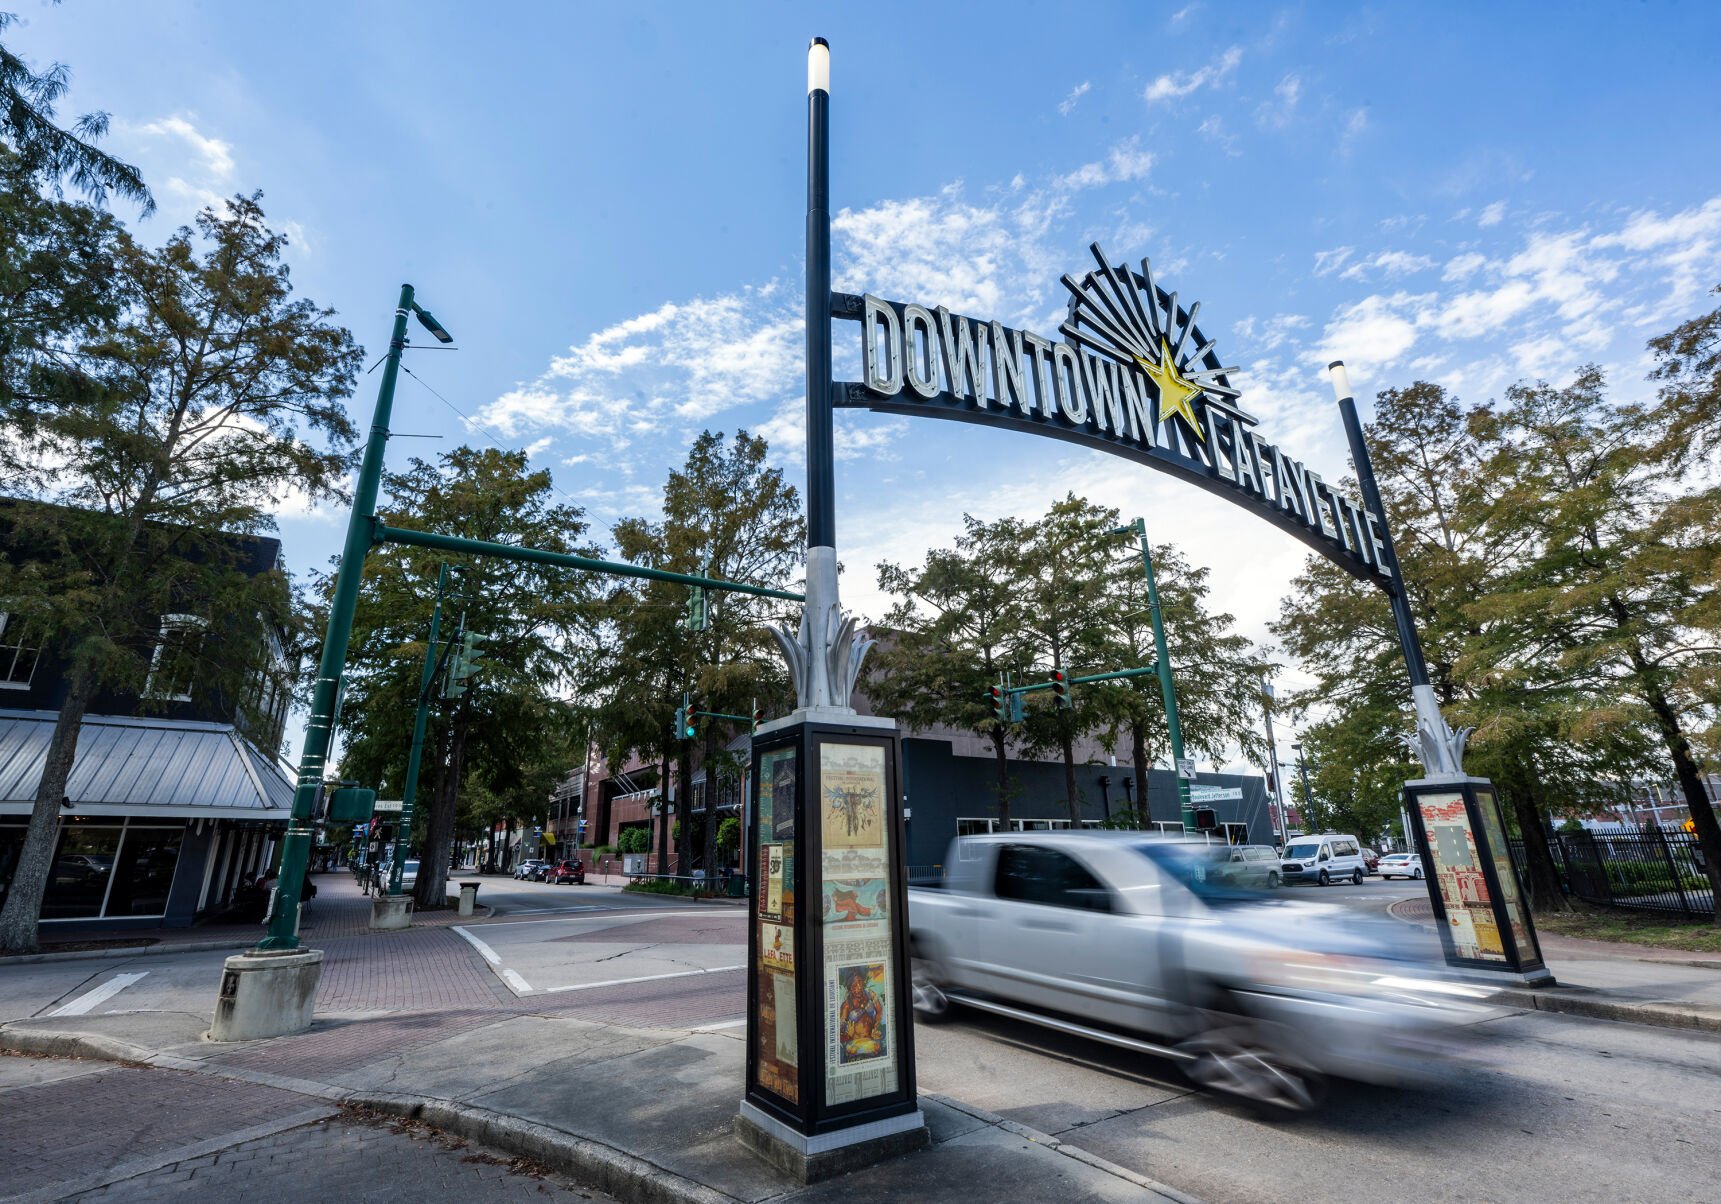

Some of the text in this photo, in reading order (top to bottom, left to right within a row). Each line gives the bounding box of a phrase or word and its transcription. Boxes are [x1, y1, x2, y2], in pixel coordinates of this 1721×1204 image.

[864, 292, 1393, 578] DOWNTOWN LAFAYETTE
[763, 949, 793, 964] LAFAETTE
